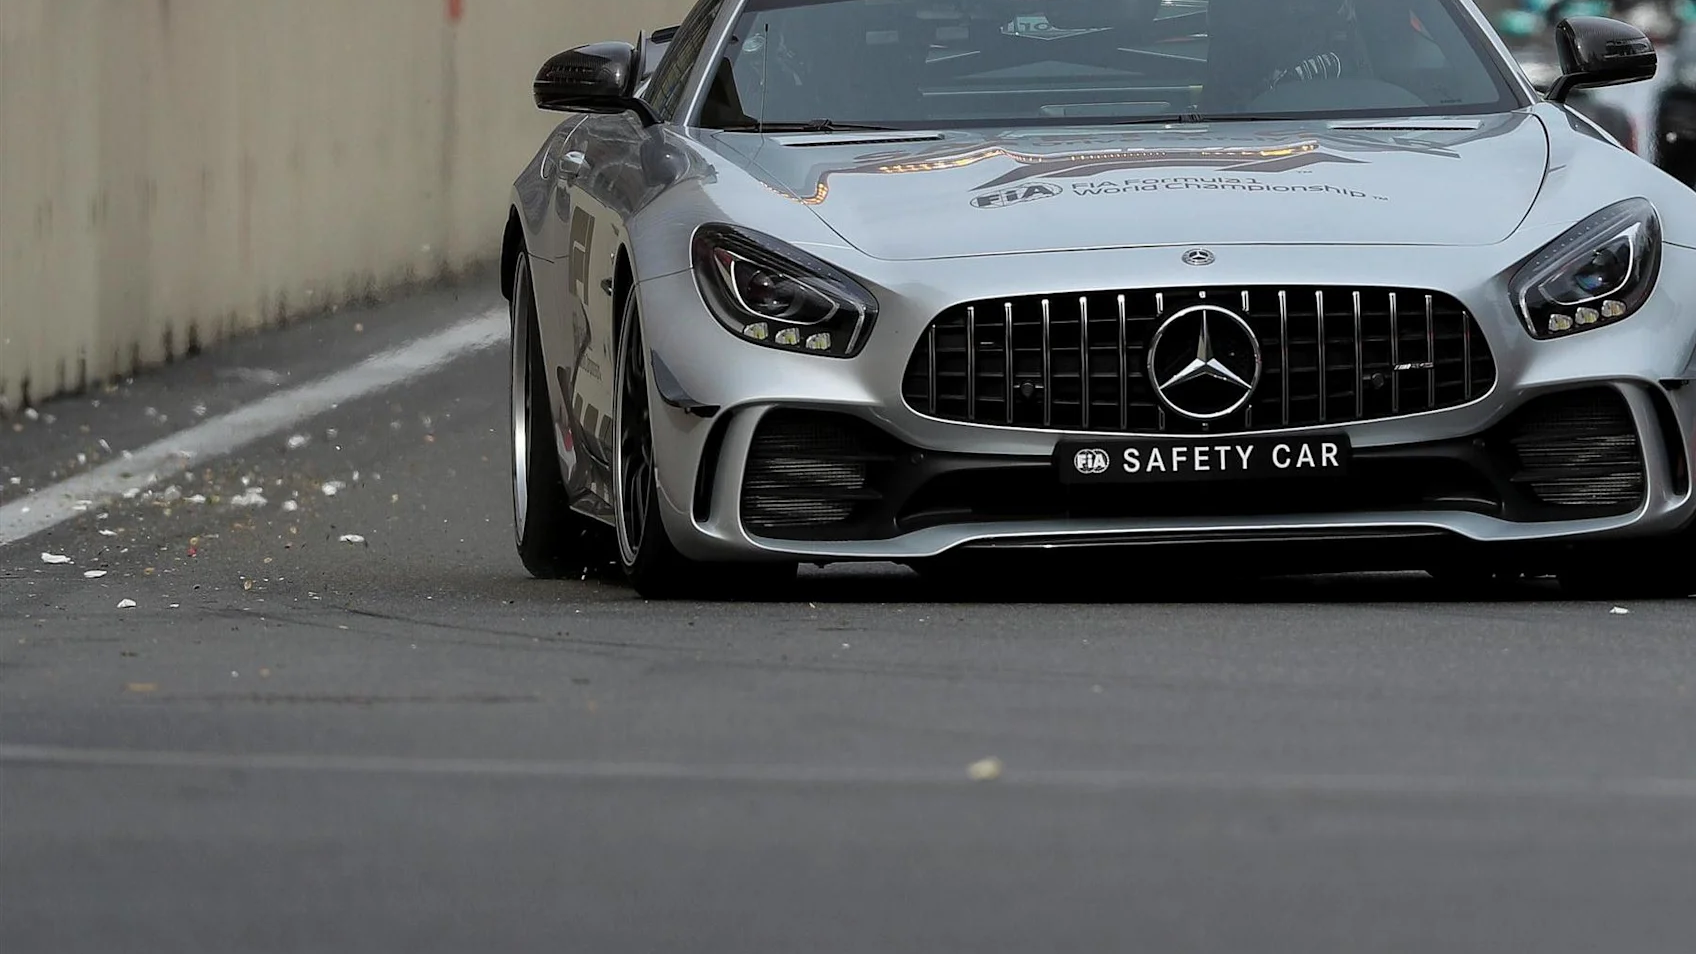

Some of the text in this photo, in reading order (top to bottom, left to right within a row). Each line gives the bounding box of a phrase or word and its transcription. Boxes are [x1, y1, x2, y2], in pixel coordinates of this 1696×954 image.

[1072, 180, 1119, 190] FIA
[1123, 177, 1243, 186] Formula
[1073, 182, 1158, 196] World
[1166, 182, 1367, 199] Championship
[1123, 445, 1254, 473] SAFETY
[1271, 442, 1340, 469] CAR
